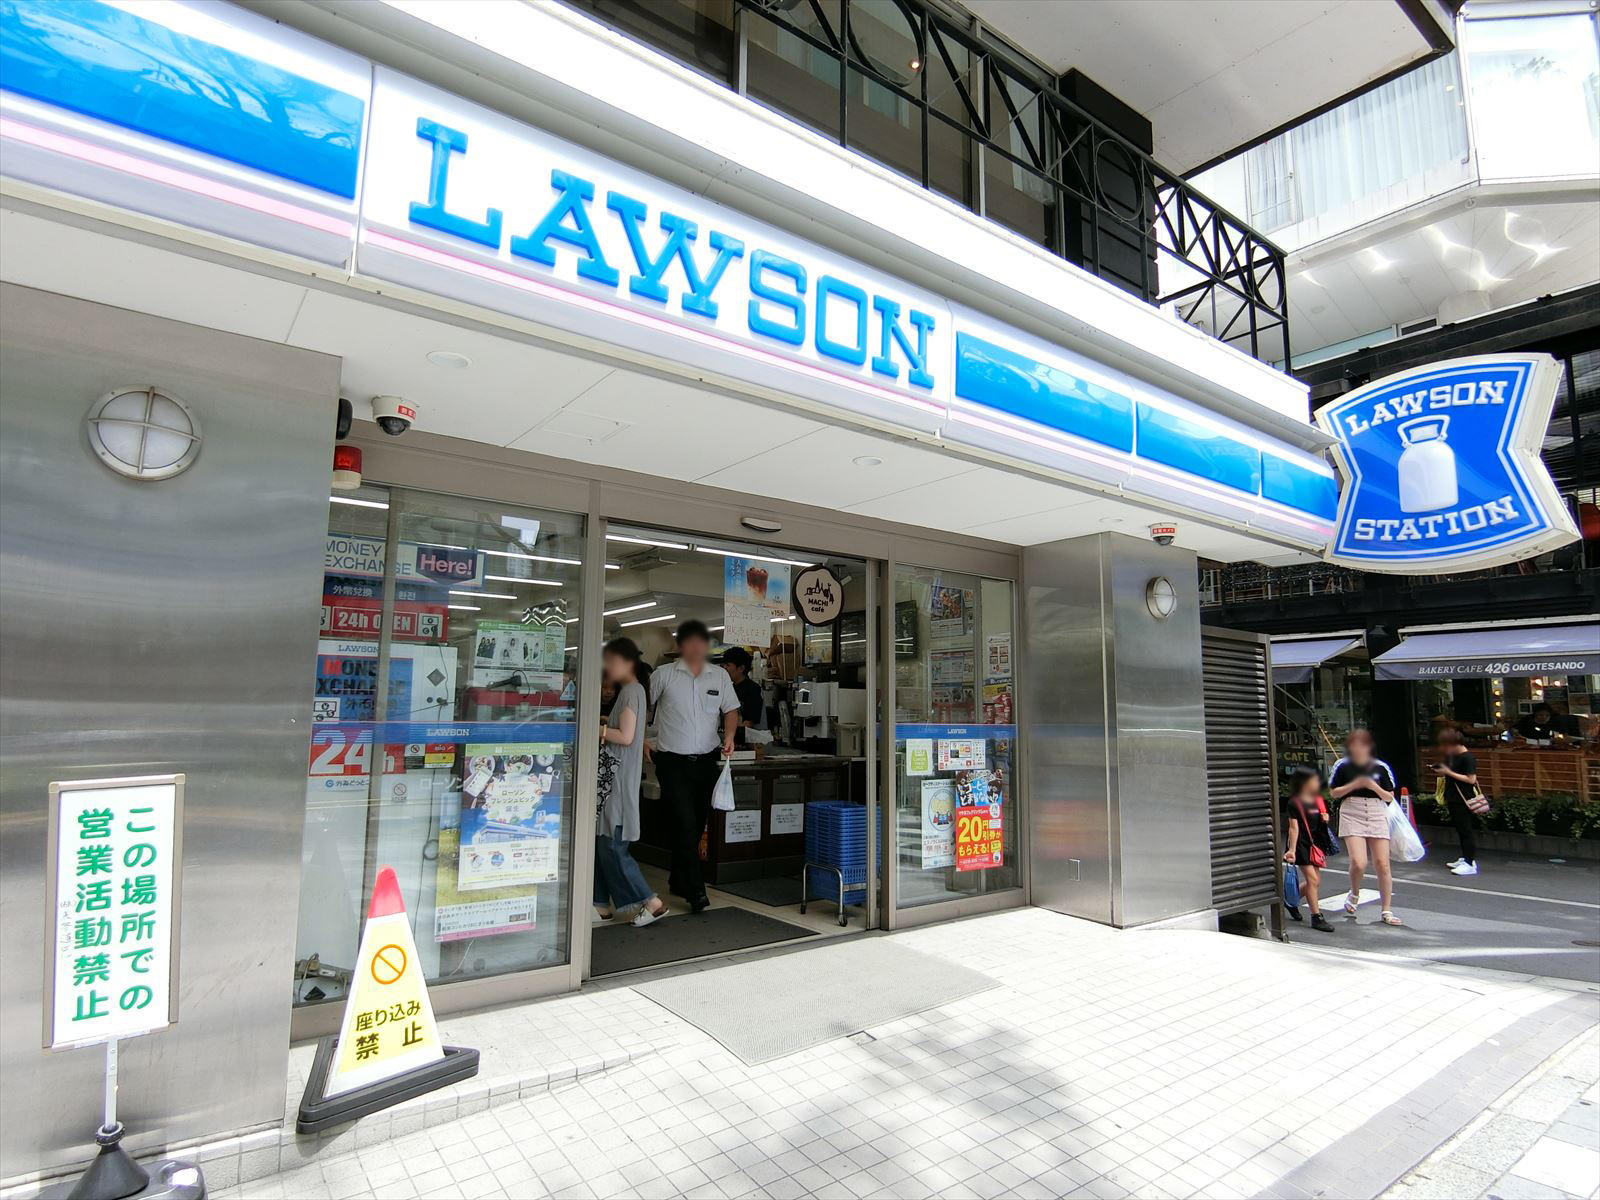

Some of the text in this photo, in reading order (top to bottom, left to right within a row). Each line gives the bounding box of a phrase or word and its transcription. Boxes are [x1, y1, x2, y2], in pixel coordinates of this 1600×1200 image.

[409, 117, 935, 389] LAWSON
[1345, 381, 1508, 436] LAWSON
[1354, 496, 1519, 541] STATION
[326, 540, 382, 557] MONEY
[420, 553, 472, 576] Here!
[808, 598, 829, 606] MACHI
[338, 611, 411, 631] 24h OEN
[1419, 661, 1586, 674] BAKERY CAFE 426 OMOTESANDO
[426, 728, 470, 737] LAWSON
[72, 807, 114, 1021] 営業活動禁止
[119, 806, 157, 1010] この場所での
[356, 1000, 421, 1031] 座り込み
